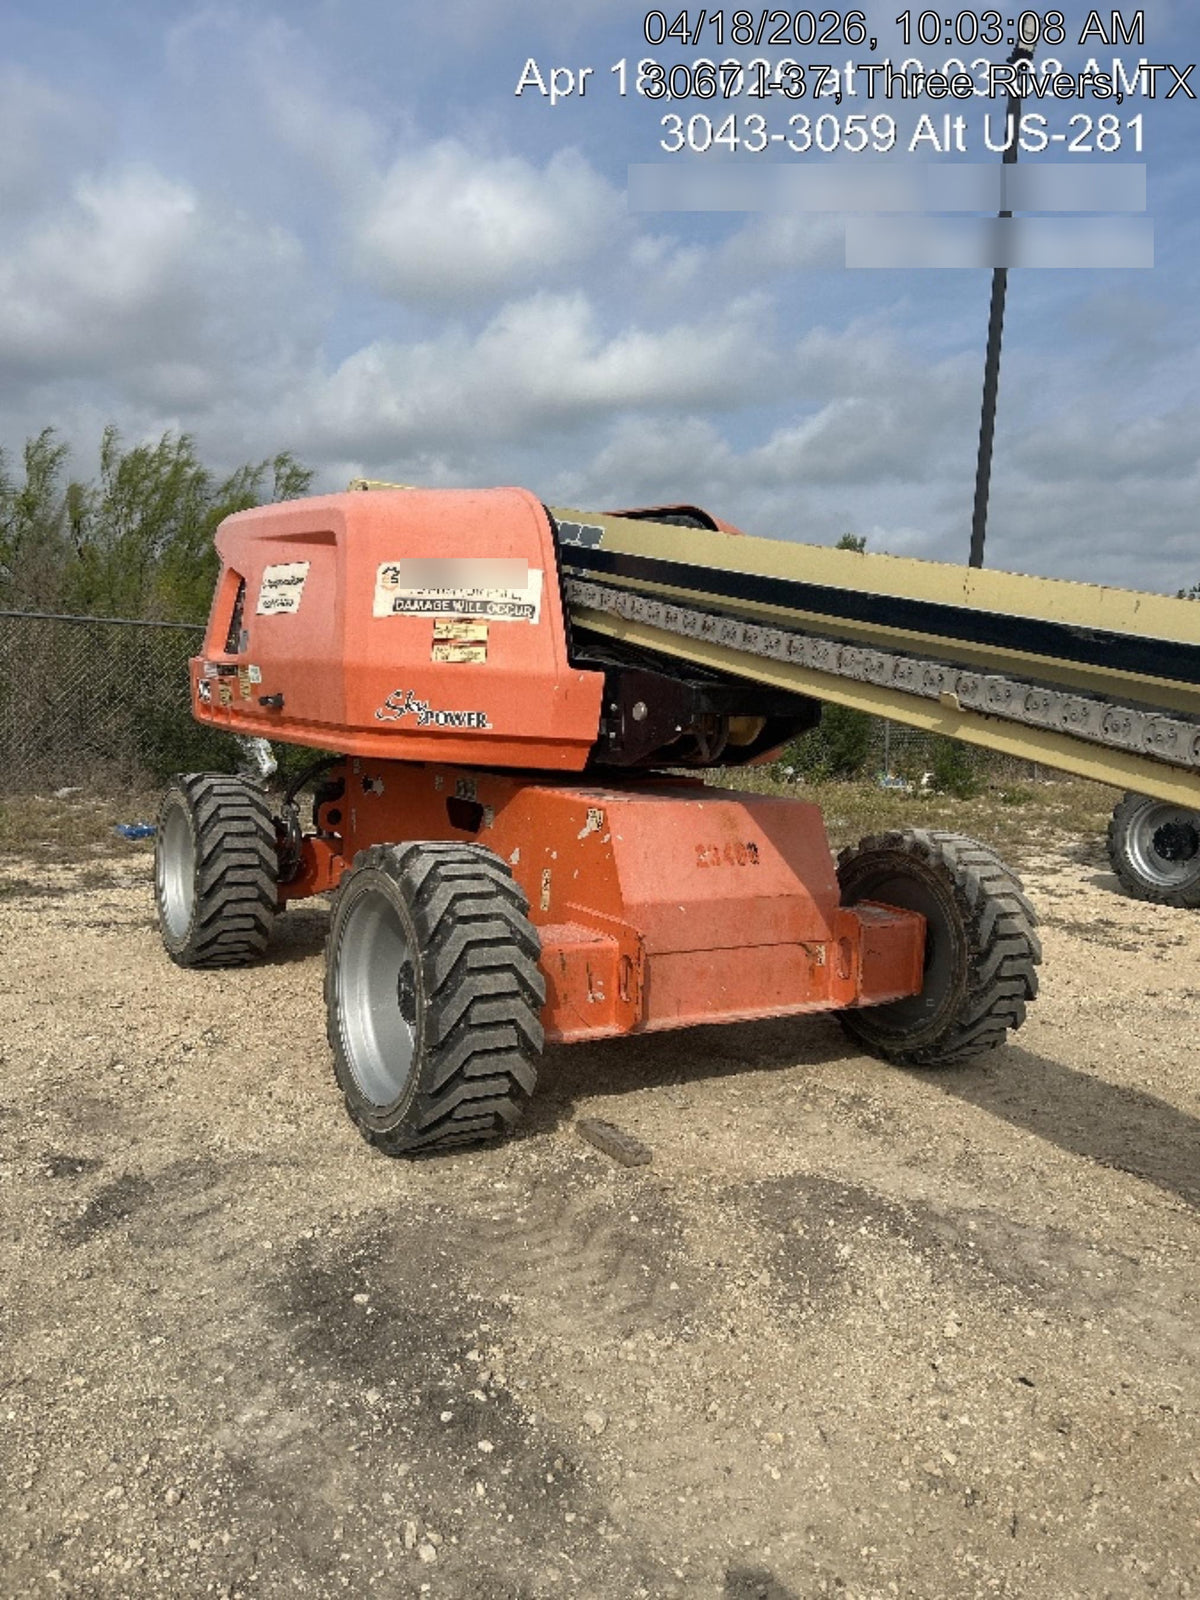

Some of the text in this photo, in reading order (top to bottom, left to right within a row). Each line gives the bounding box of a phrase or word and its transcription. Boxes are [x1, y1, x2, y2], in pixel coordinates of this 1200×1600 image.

[395, 599, 534, 618] DAMAGE WILL OCCUR
[422, 709, 488, 729] POWER
